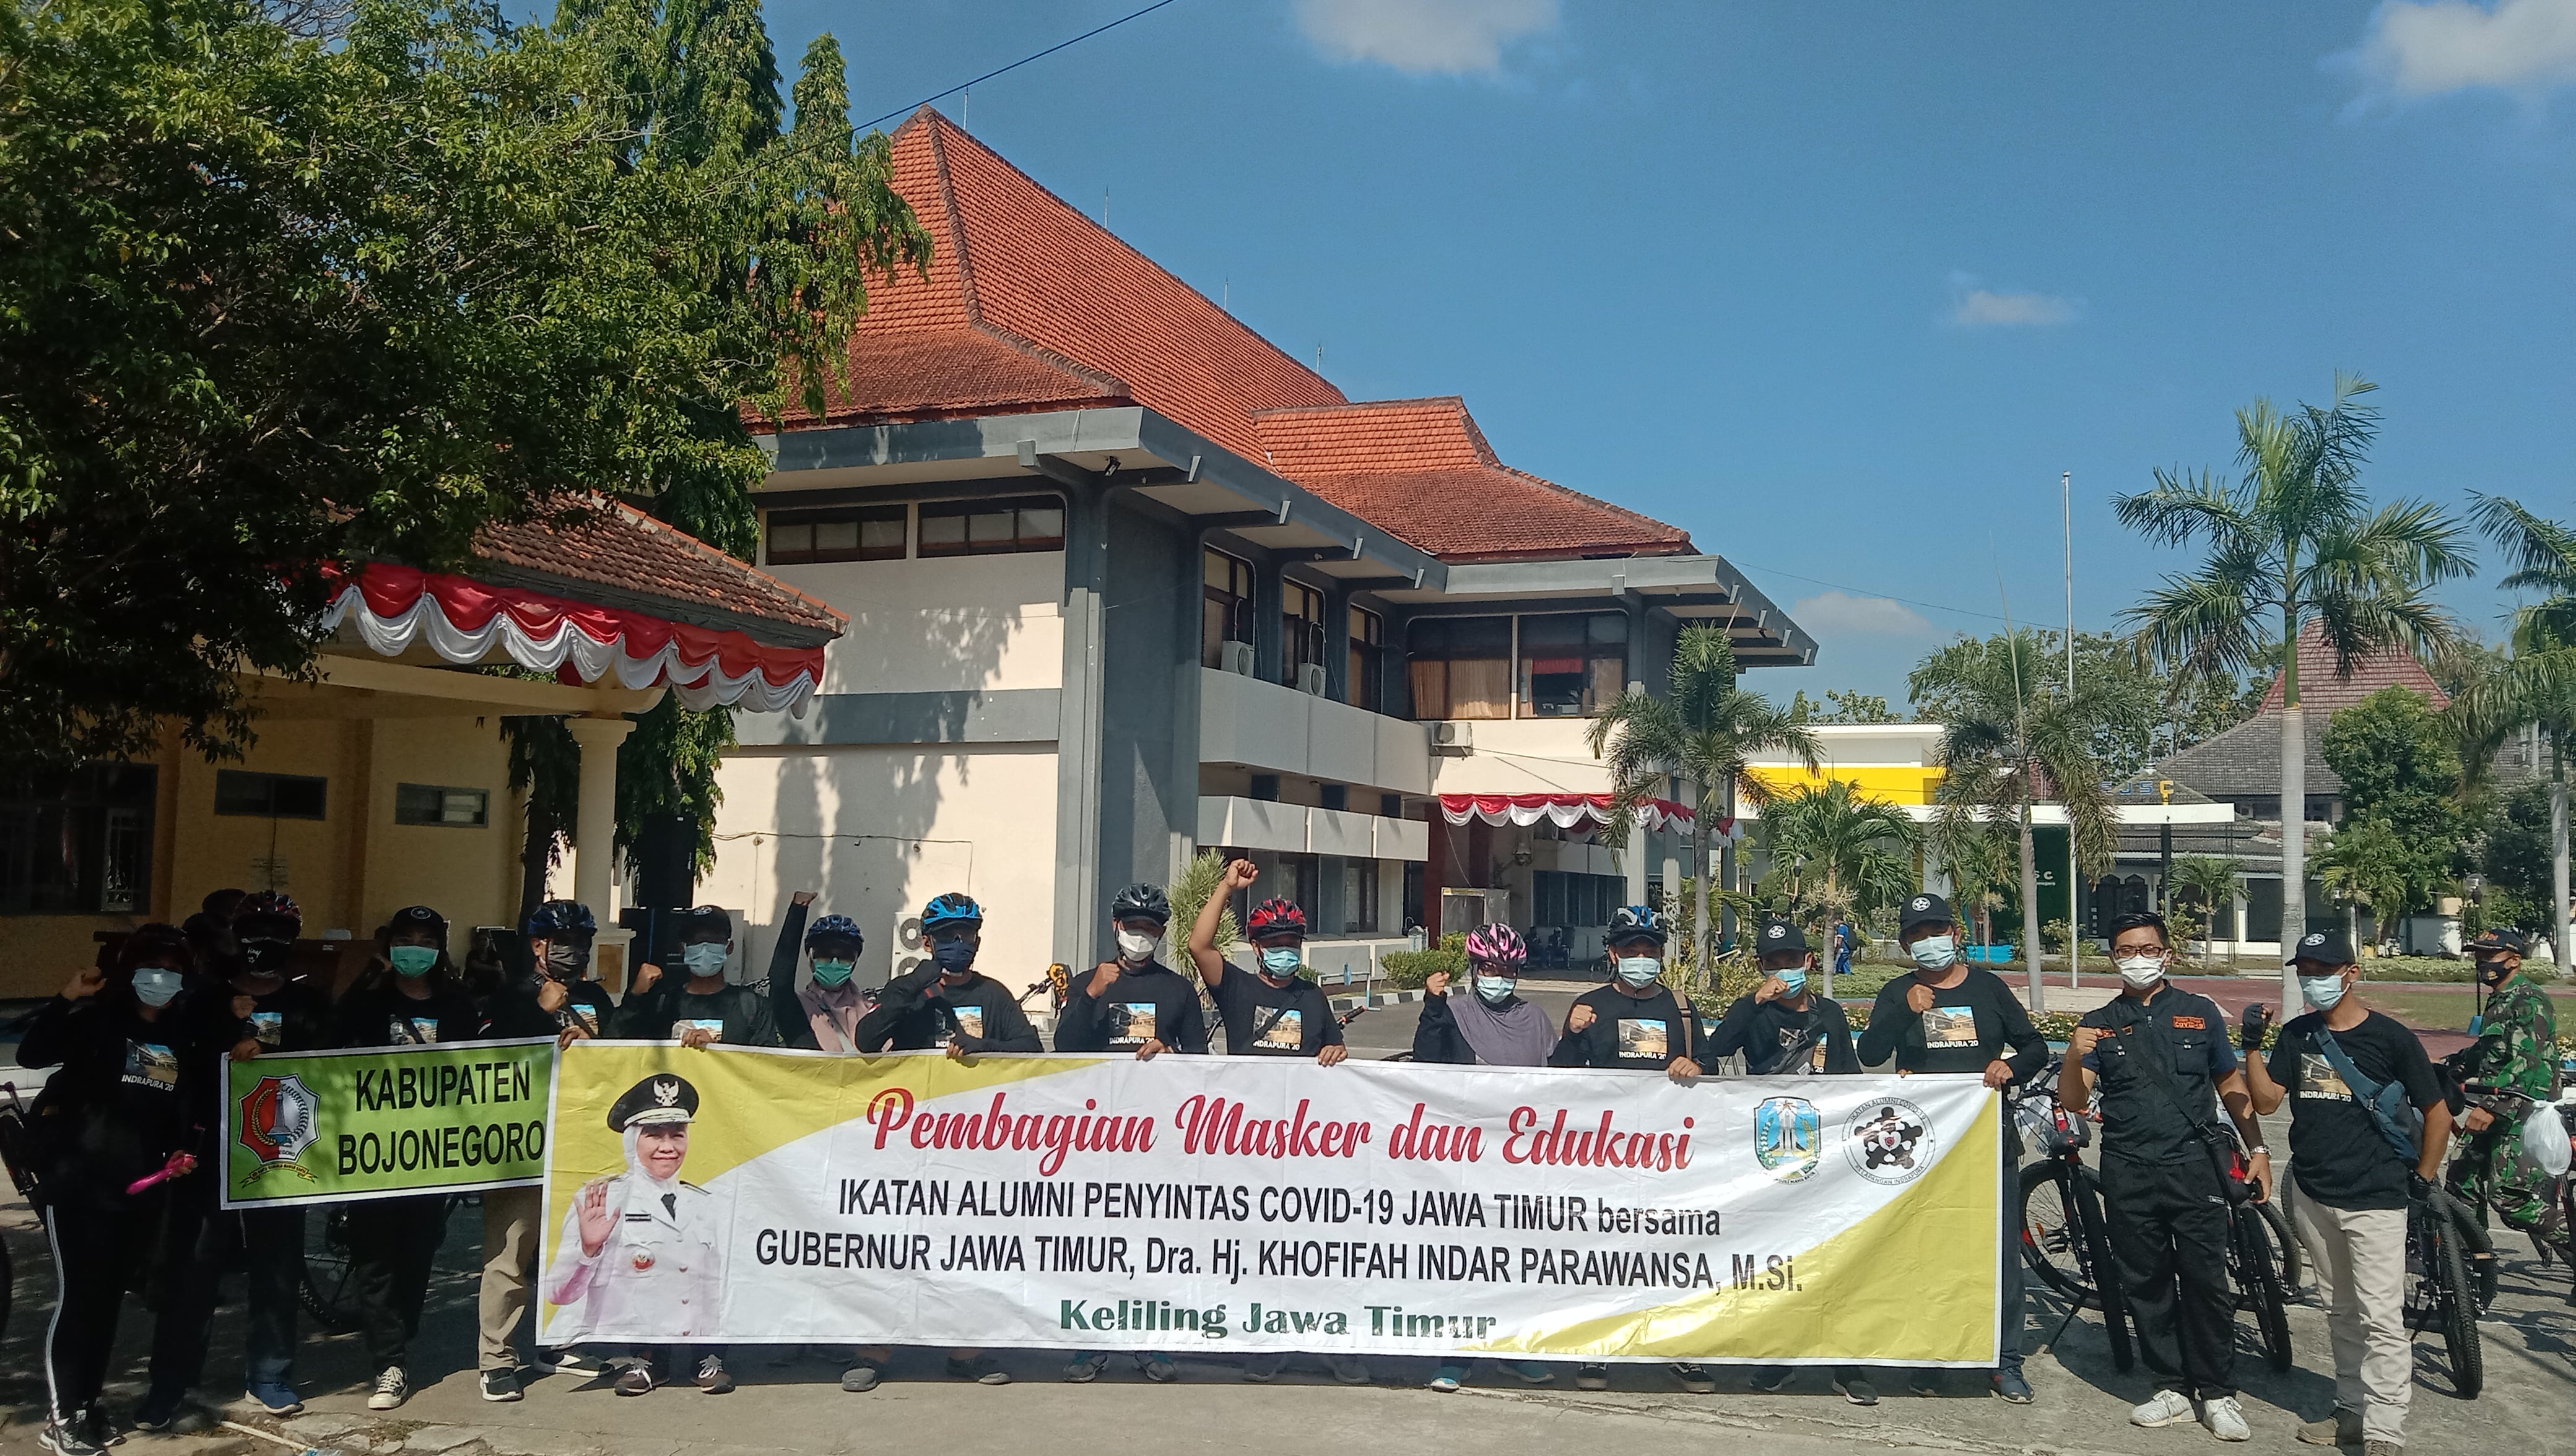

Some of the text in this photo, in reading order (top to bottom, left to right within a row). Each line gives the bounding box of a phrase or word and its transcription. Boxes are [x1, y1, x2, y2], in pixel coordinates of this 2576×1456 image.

[1109, 1036, 1145, 1044] INDRAPURA
[1926, 1041, 1969, 1049] INDRAPURA
[1619, 1051, 1657, 1059] INDRAPURA
[121, 1074, 164, 1090] INDRAPURA
[356, 1060, 531, 1112] KABUPATEN
[2299, 1091, 2340, 1100] INDRAPURA
[1850, 1097, 1926, 1120] IKATAN ALUMNI COVID-19
[867, 1087, 1695, 1177] Pembagian Masker dan Edukasi
[338, 1120, 545, 1176] BOJONEGORO
[1861, 1171, 1892, 1184] LAPANGAN
[1894, 1165, 1925, 1184] INDRAPURA
[839, 1179, 1721, 1236] IKATAN ALUMNI PENYINTAS COVID-19 JAWA TIMUR bersama
[756, 1228, 1803, 1296] GUBERNUR JAWA TIMUR, Dra. Hj. KHOFIFAH INDAR PARAWANSA, M.Si.
[1060, 1299, 1497, 1339] Keliling Jawa Timur
